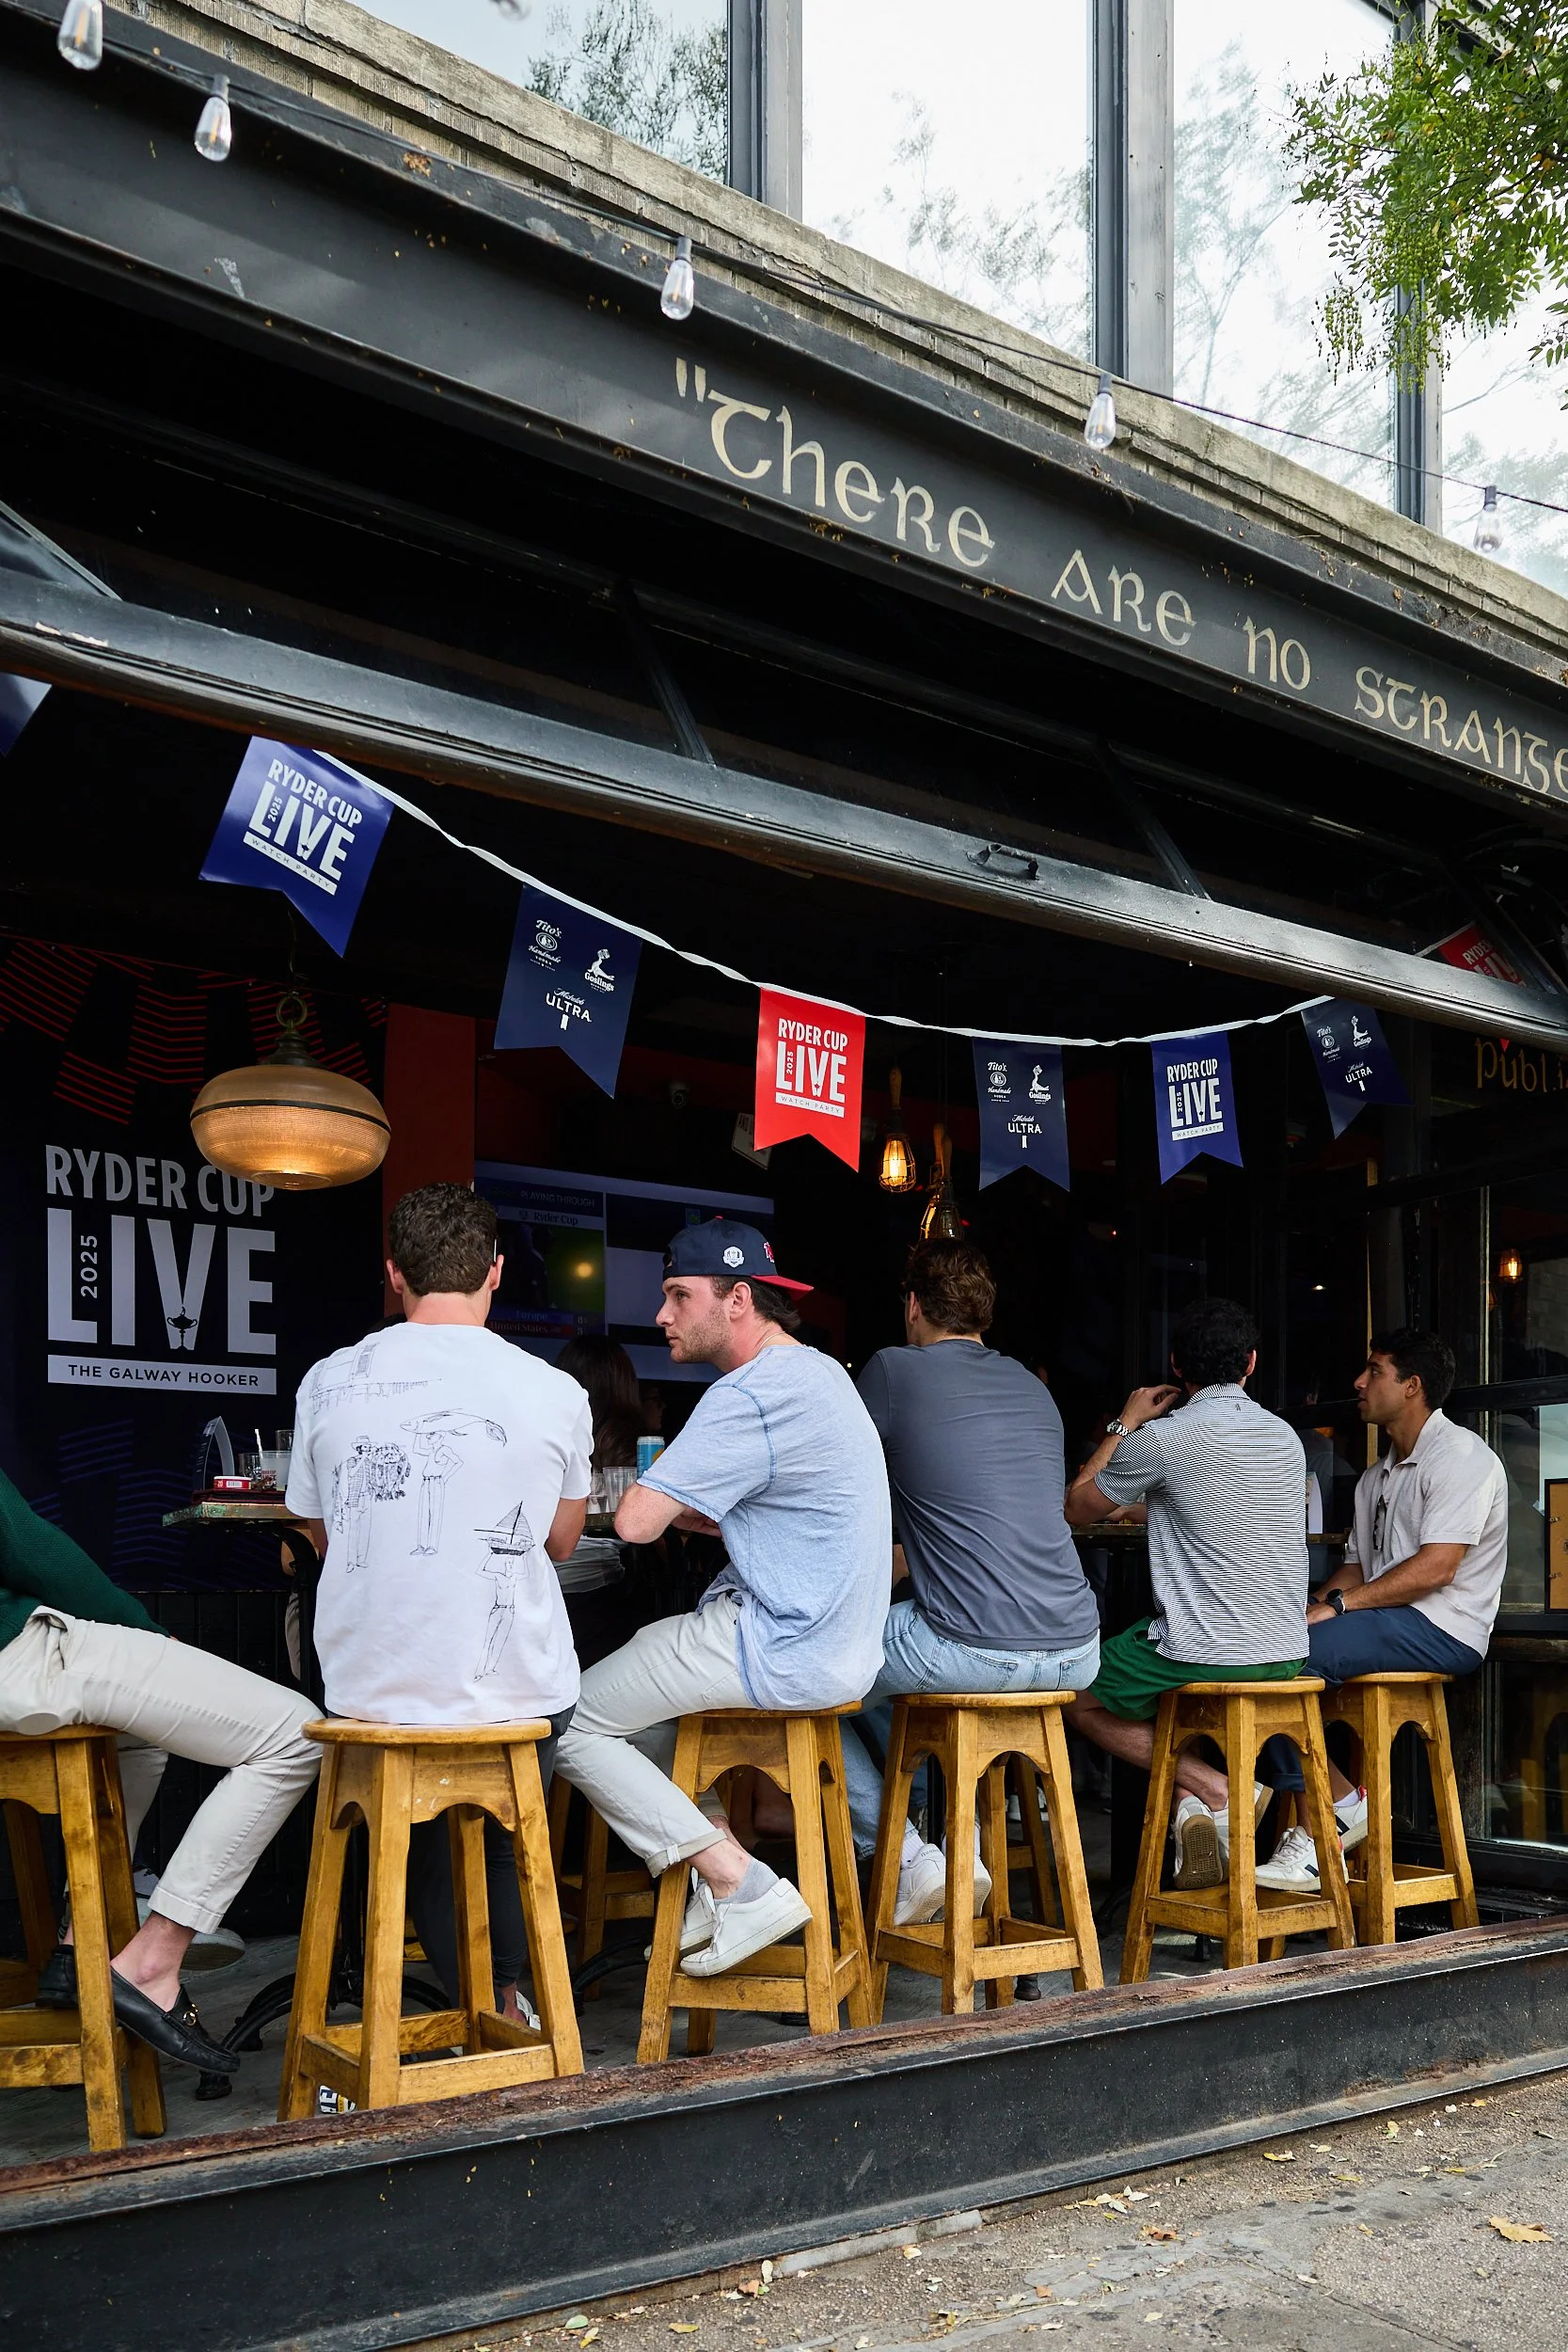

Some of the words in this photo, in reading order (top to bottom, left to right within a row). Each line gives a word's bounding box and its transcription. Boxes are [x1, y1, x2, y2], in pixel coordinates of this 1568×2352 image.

[267, 758, 328, 810] RYDER
[327, 796, 363, 828] CUP
[267, 796, 283, 821] 2025
[248, 780, 356, 882] LIVE
[252, 838, 290, 864] WATCH
[295, 865, 330, 887] PARTY
[535, 919, 562, 939] Tito's
[584, 972, 614, 992] Goslings
[546, 993, 592, 1023] ULTRA
[778, 1018, 821, 1046] RYDER
[823, 1030, 847, 1052] CUP
[776, 1040, 847, 1104] LIVE
[988, 1062, 1007, 1072] Tito's
[1166, 1061, 1200, 1083] RYDER
[1200, 1058, 1218, 1077] CUP
[1345, 1066, 1373, 1083] ULTRA
[781, 1096, 810, 1107] WATCH
[815, 1103, 840, 1114] PARTY
[1168, 1077, 1223, 1128] LIVE
[1007, 1122, 1042, 1134] ULTRA
[1176, 1129, 1198, 1137] WATCH
[1201, 1124, 1221, 1133] PARTY
[45, 1144, 188, 1210] RYDER
[197, 1165, 275, 1217] CUP
[520, 1189, 555, 1201] PLAYING
[555, 1194, 594, 1207] THROUGH
[533, 1212, 559, 1223] Ryder
[561, 1215, 578, 1226] Cup
[80, 1234, 98, 1298] 2025
[47, 1207, 277, 1356] LIVE
[68, 1364, 102, 1378] THE
[109, 1367, 182, 1383] GALWAY
[188, 1372, 259, 1387] HOOKER
